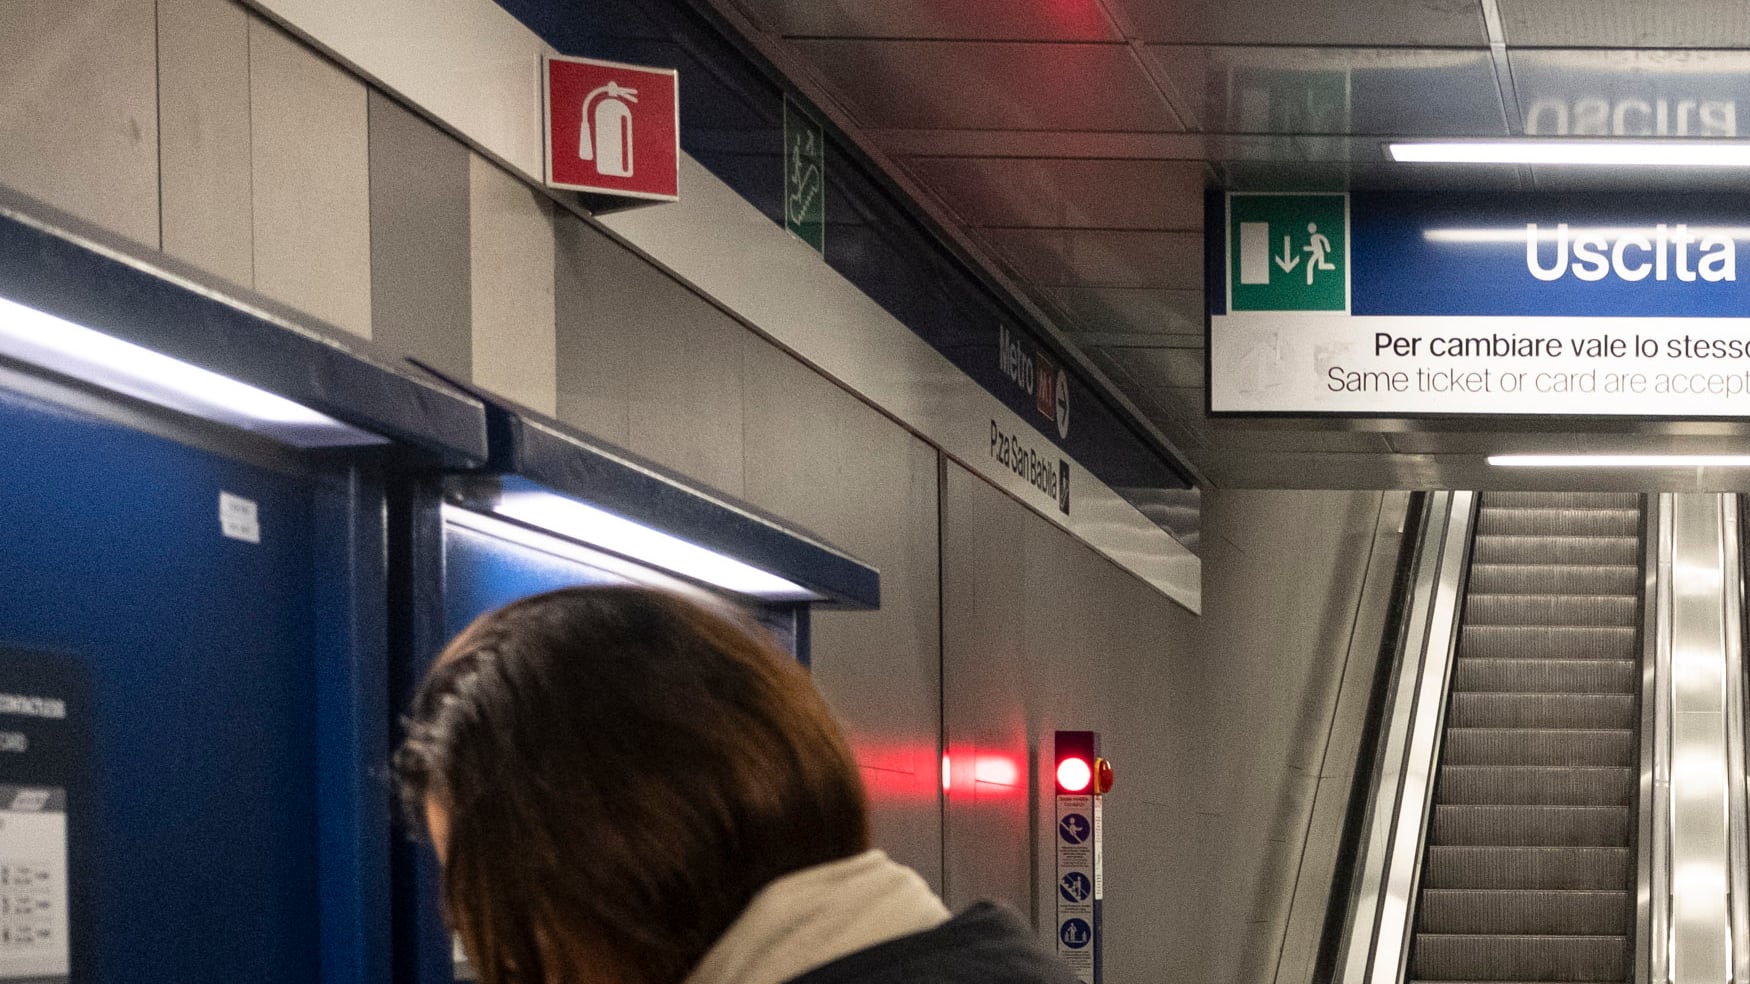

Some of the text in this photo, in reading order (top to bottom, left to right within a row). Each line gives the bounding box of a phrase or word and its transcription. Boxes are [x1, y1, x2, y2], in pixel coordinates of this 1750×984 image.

[1525, 222, 1737, 283] Uscita
[999, 323, 1034, 396] Metro
[1374, 332, 1422, 357] Per
[1429, 332, 1563, 358] cambiare
[1570, 333, 1627, 358] vale
[1635, 334, 1659, 359] lo
[1326, 366, 1410, 393] Same
[1415, 367, 1493, 393] ticket
[1499, 371, 1527, 393] or
[1535, 368, 1597, 394] card
[1604, 372, 1648, 394] are
[990, 418, 1058, 501] P.za San Babila
